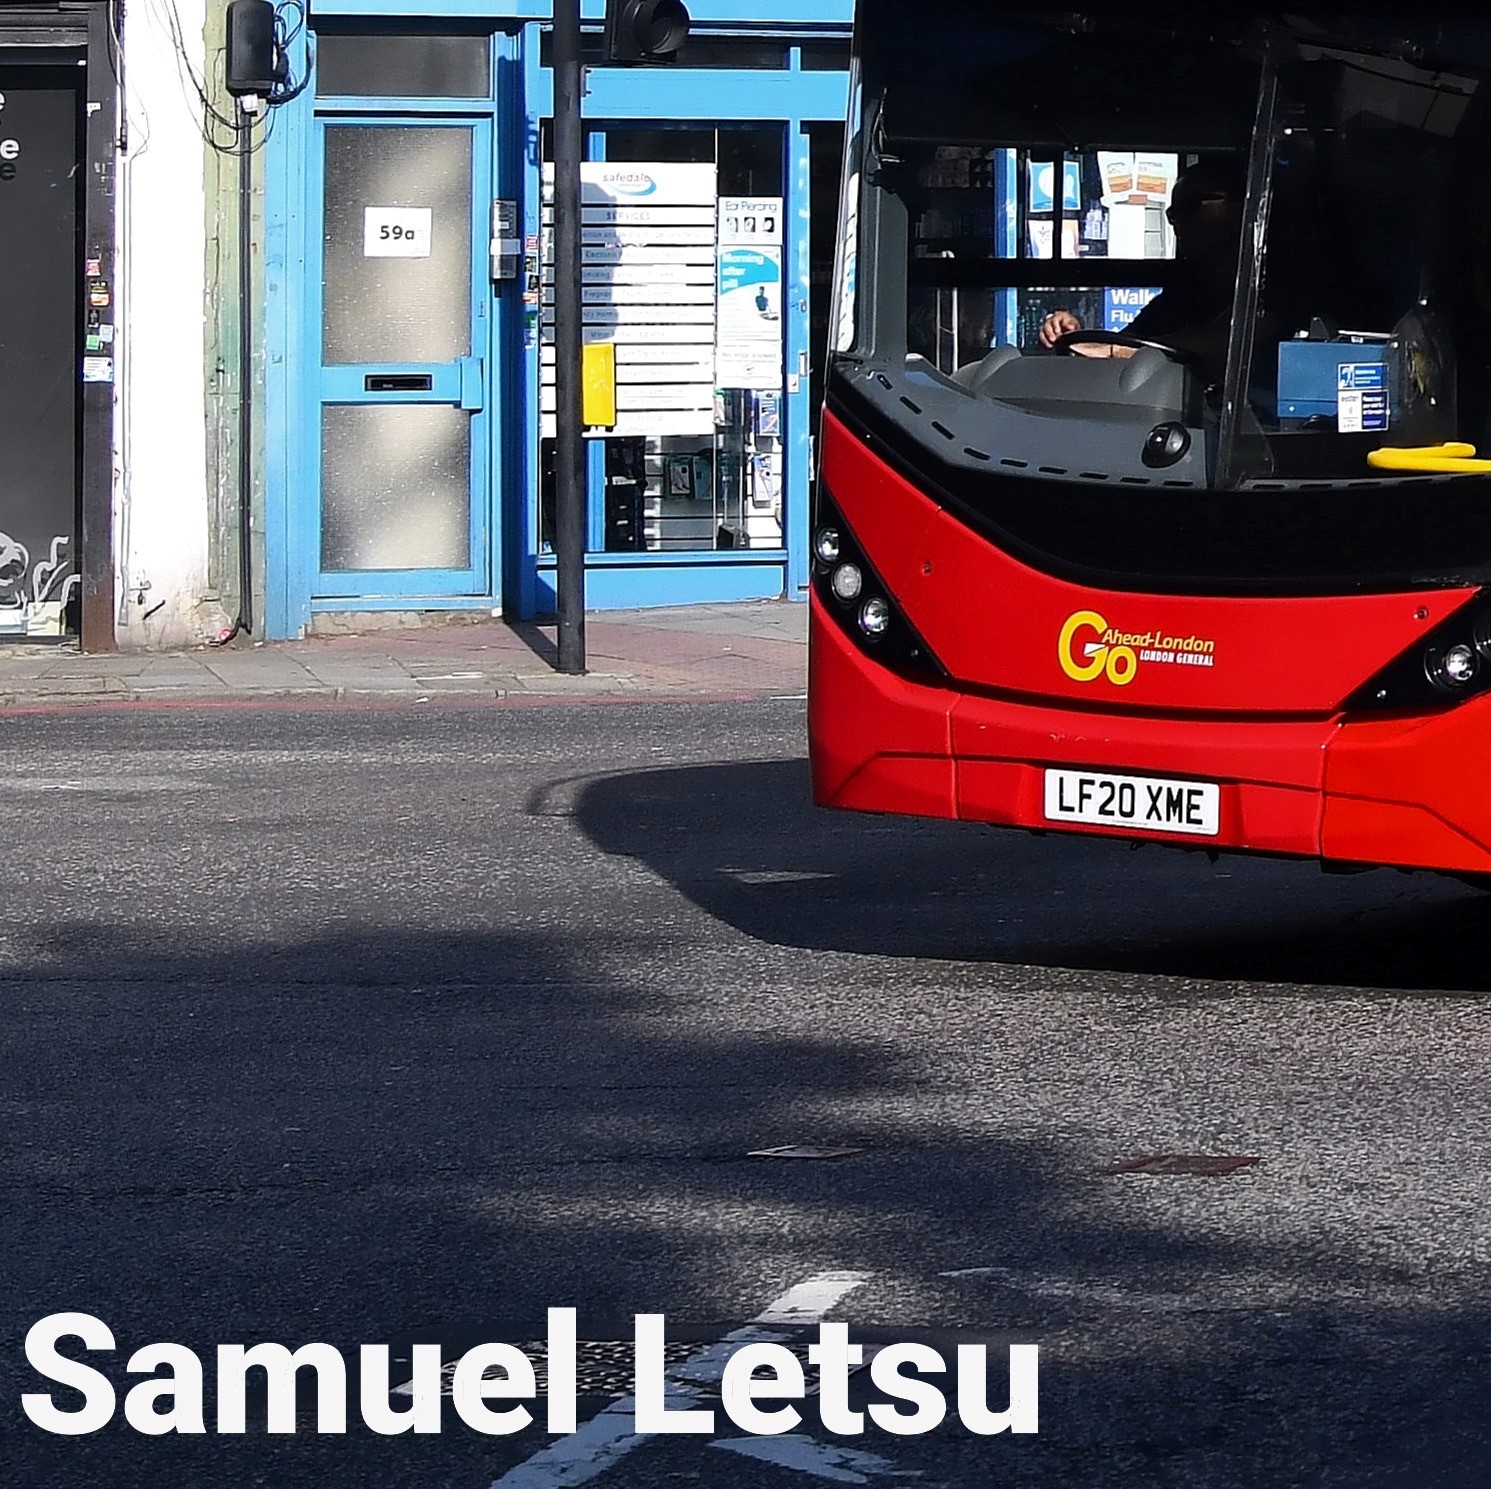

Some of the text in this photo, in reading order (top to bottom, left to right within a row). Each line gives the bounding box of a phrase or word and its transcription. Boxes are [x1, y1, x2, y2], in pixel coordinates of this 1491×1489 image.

[379, 225, 416, 241] 59a
[1057, 609, 1215, 686] Go Ahead-London
[1139, 649, 1214, 667] LONDON GENERAL
[1058, 776, 1205, 826] LF20 XME
